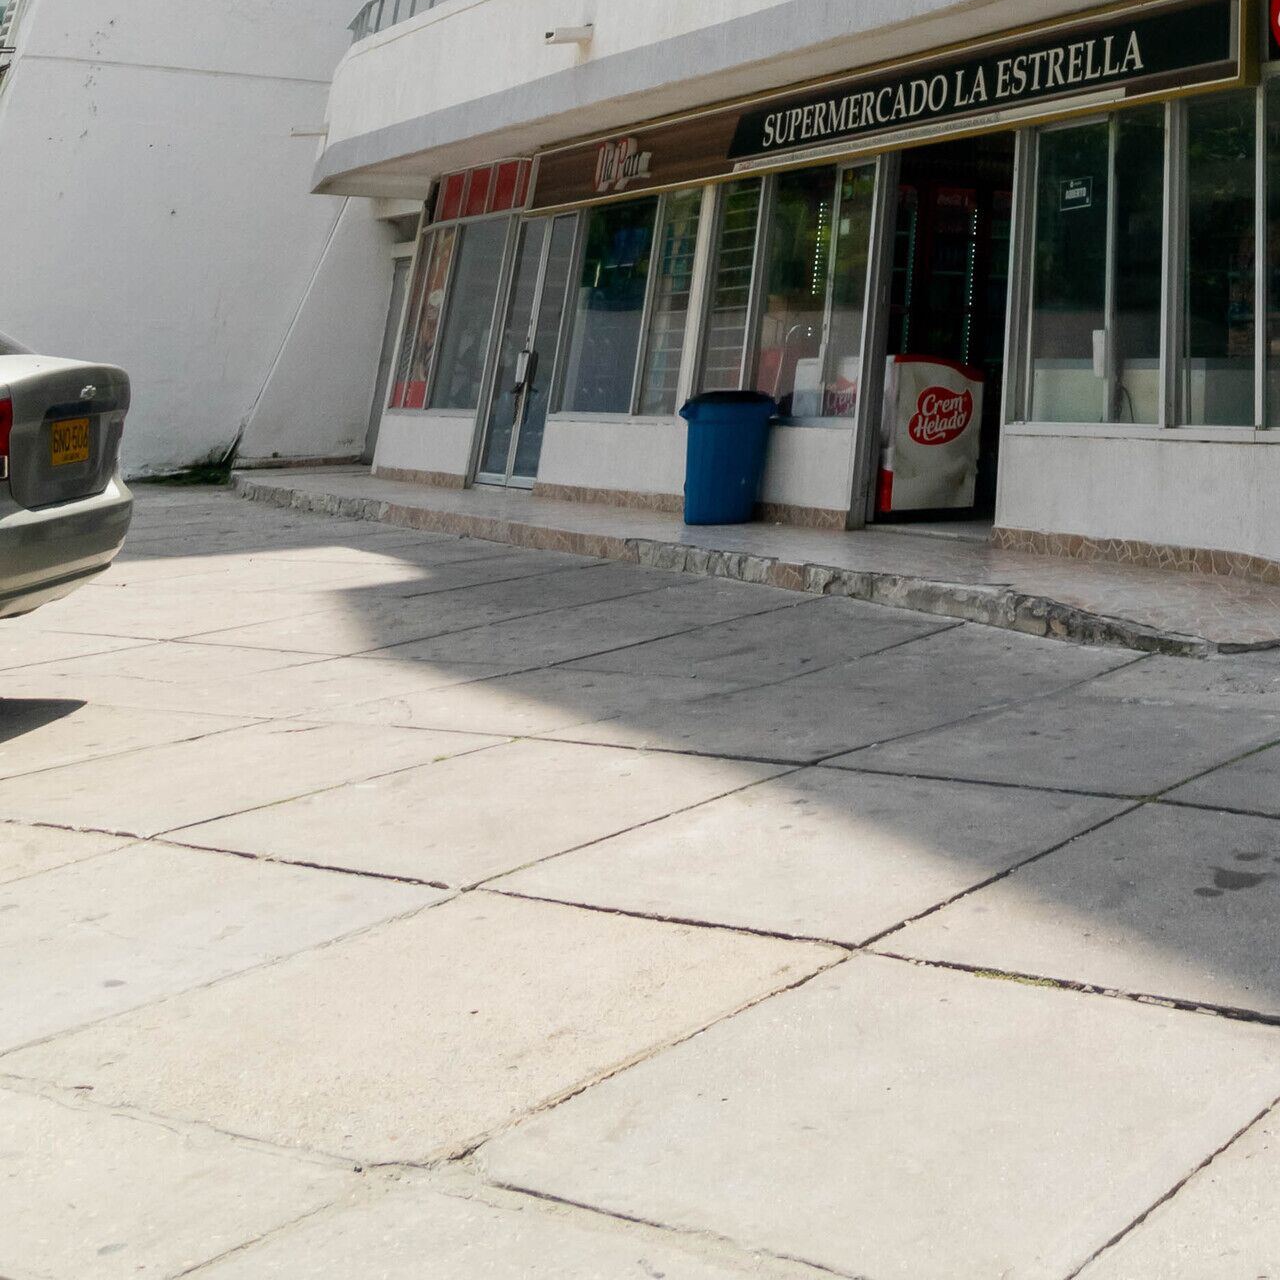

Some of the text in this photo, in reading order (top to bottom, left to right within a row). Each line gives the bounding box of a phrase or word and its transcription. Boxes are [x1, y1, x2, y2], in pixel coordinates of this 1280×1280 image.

[762, 74, 948, 148] SUPERMERCADO
[954, 65, 988, 107] LA
[995, 30, 1144, 99] ESTRELLA
[922, 394, 963, 417] Crem
[914, 410, 967, 441] Helado
